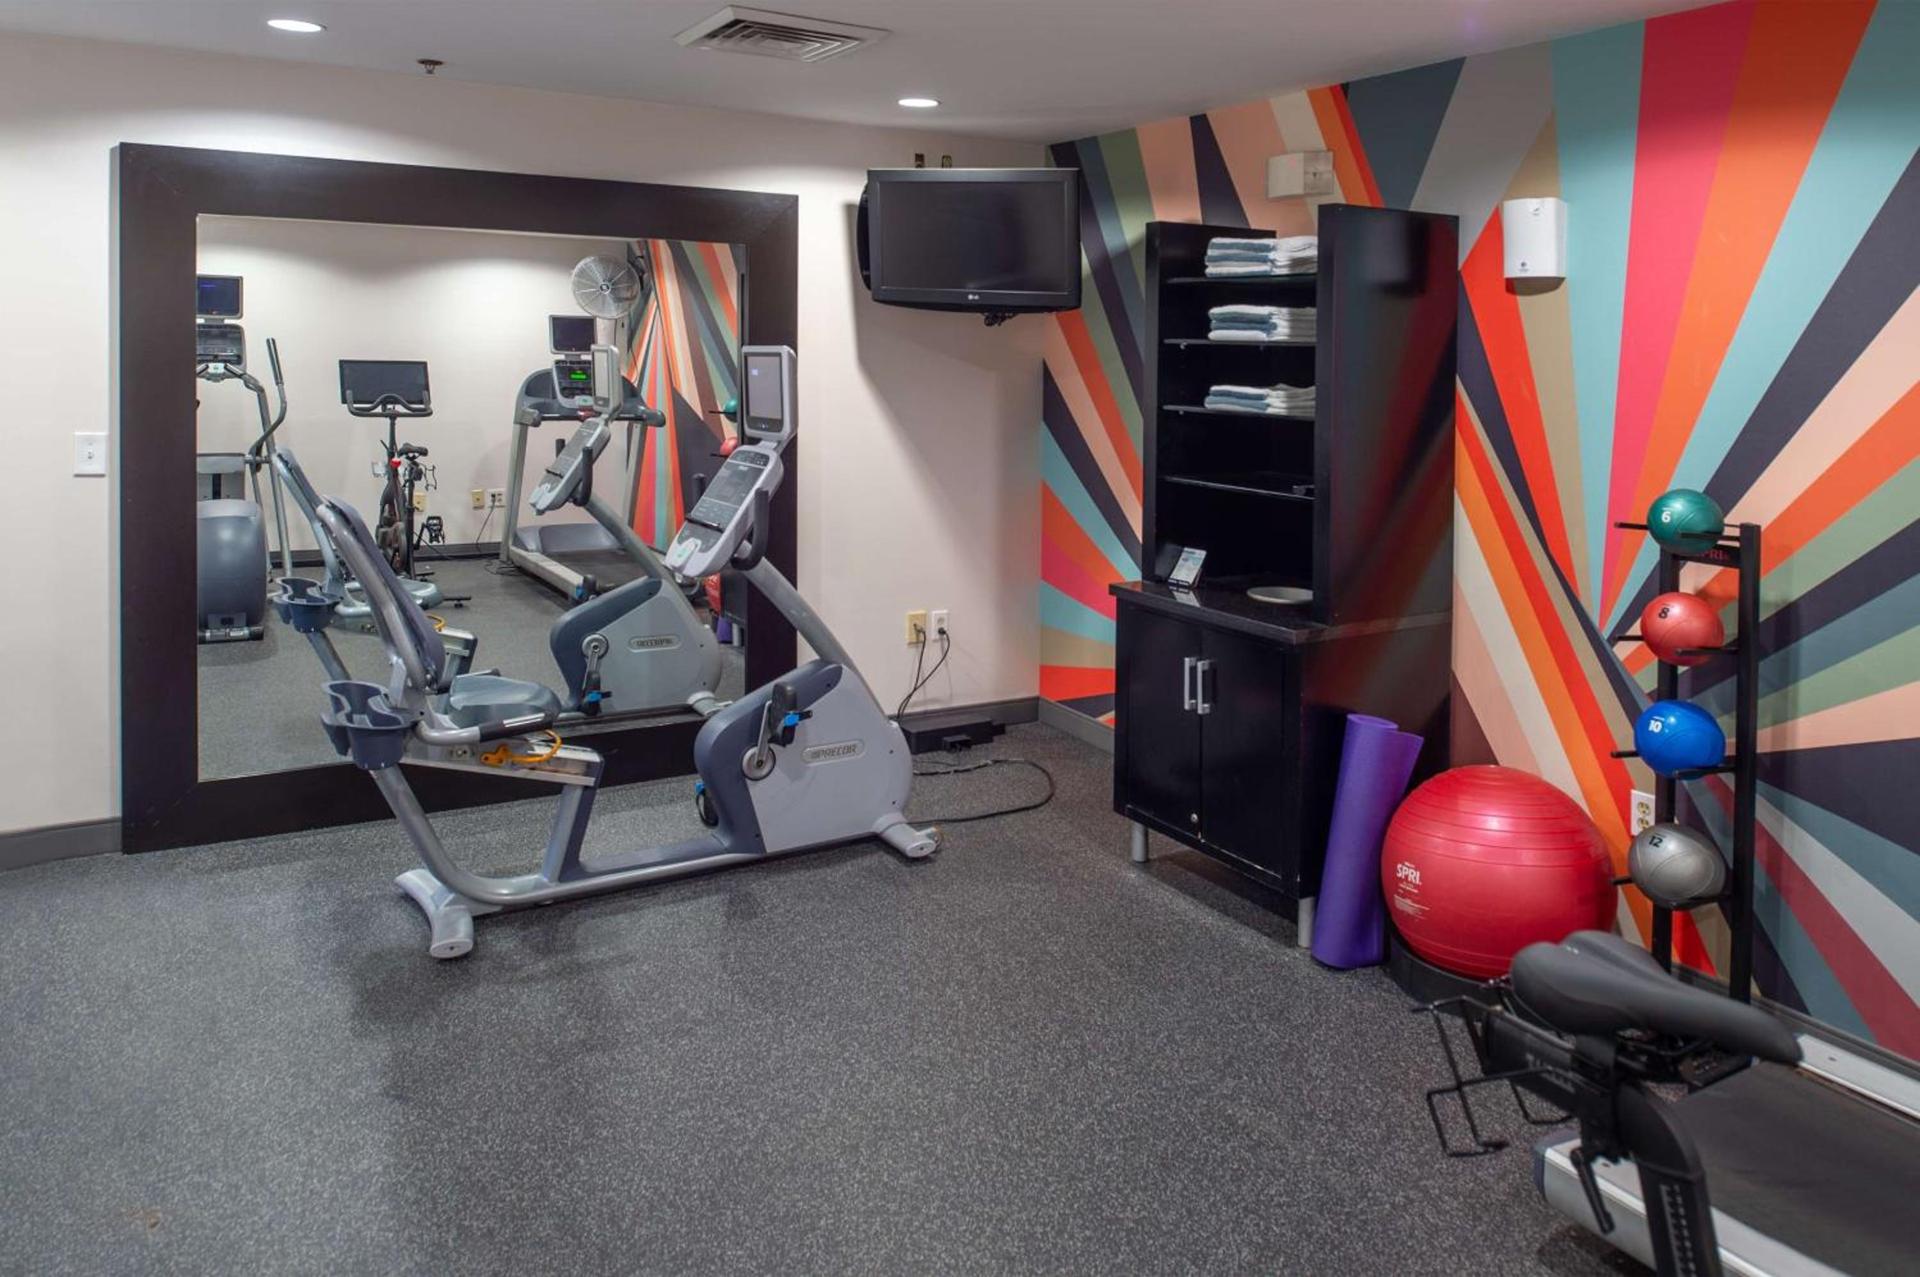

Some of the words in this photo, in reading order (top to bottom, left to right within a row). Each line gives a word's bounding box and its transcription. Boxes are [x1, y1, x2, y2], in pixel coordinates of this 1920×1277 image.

[1661, 511, 1671, 523] 6
[1658, 606, 1670, 619] 8
[1648, 719, 1663, 733] 10
[1648, 835, 1663, 848] 12
[1396, 862, 1420, 885] SPRI
